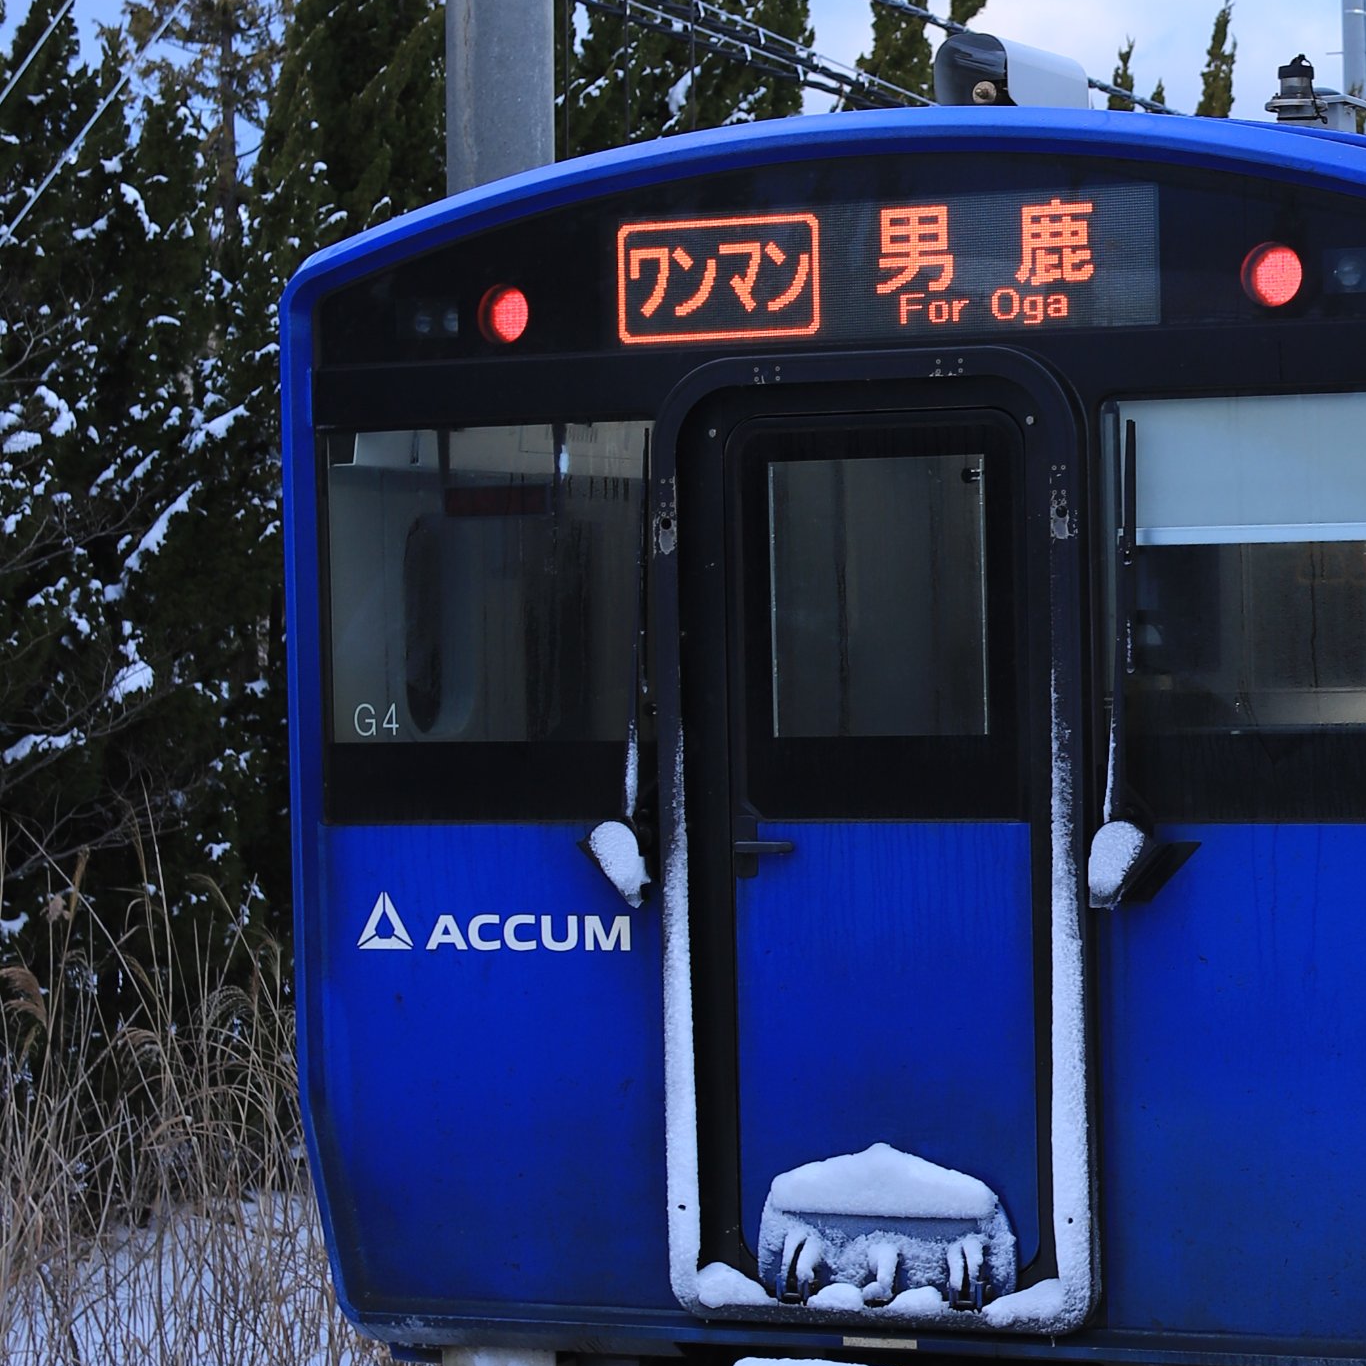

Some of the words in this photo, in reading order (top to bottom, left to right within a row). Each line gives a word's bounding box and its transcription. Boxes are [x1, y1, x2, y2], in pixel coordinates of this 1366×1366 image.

[875, 199, 1096, 295] 男鹿
[629, 241, 810, 318] ワンマン
[899, 292, 970, 325] For
[990, 288, 1068, 325] Oga
[354, 703, 400, 736] G4
[425, 914, 632, 952] ACCUM
